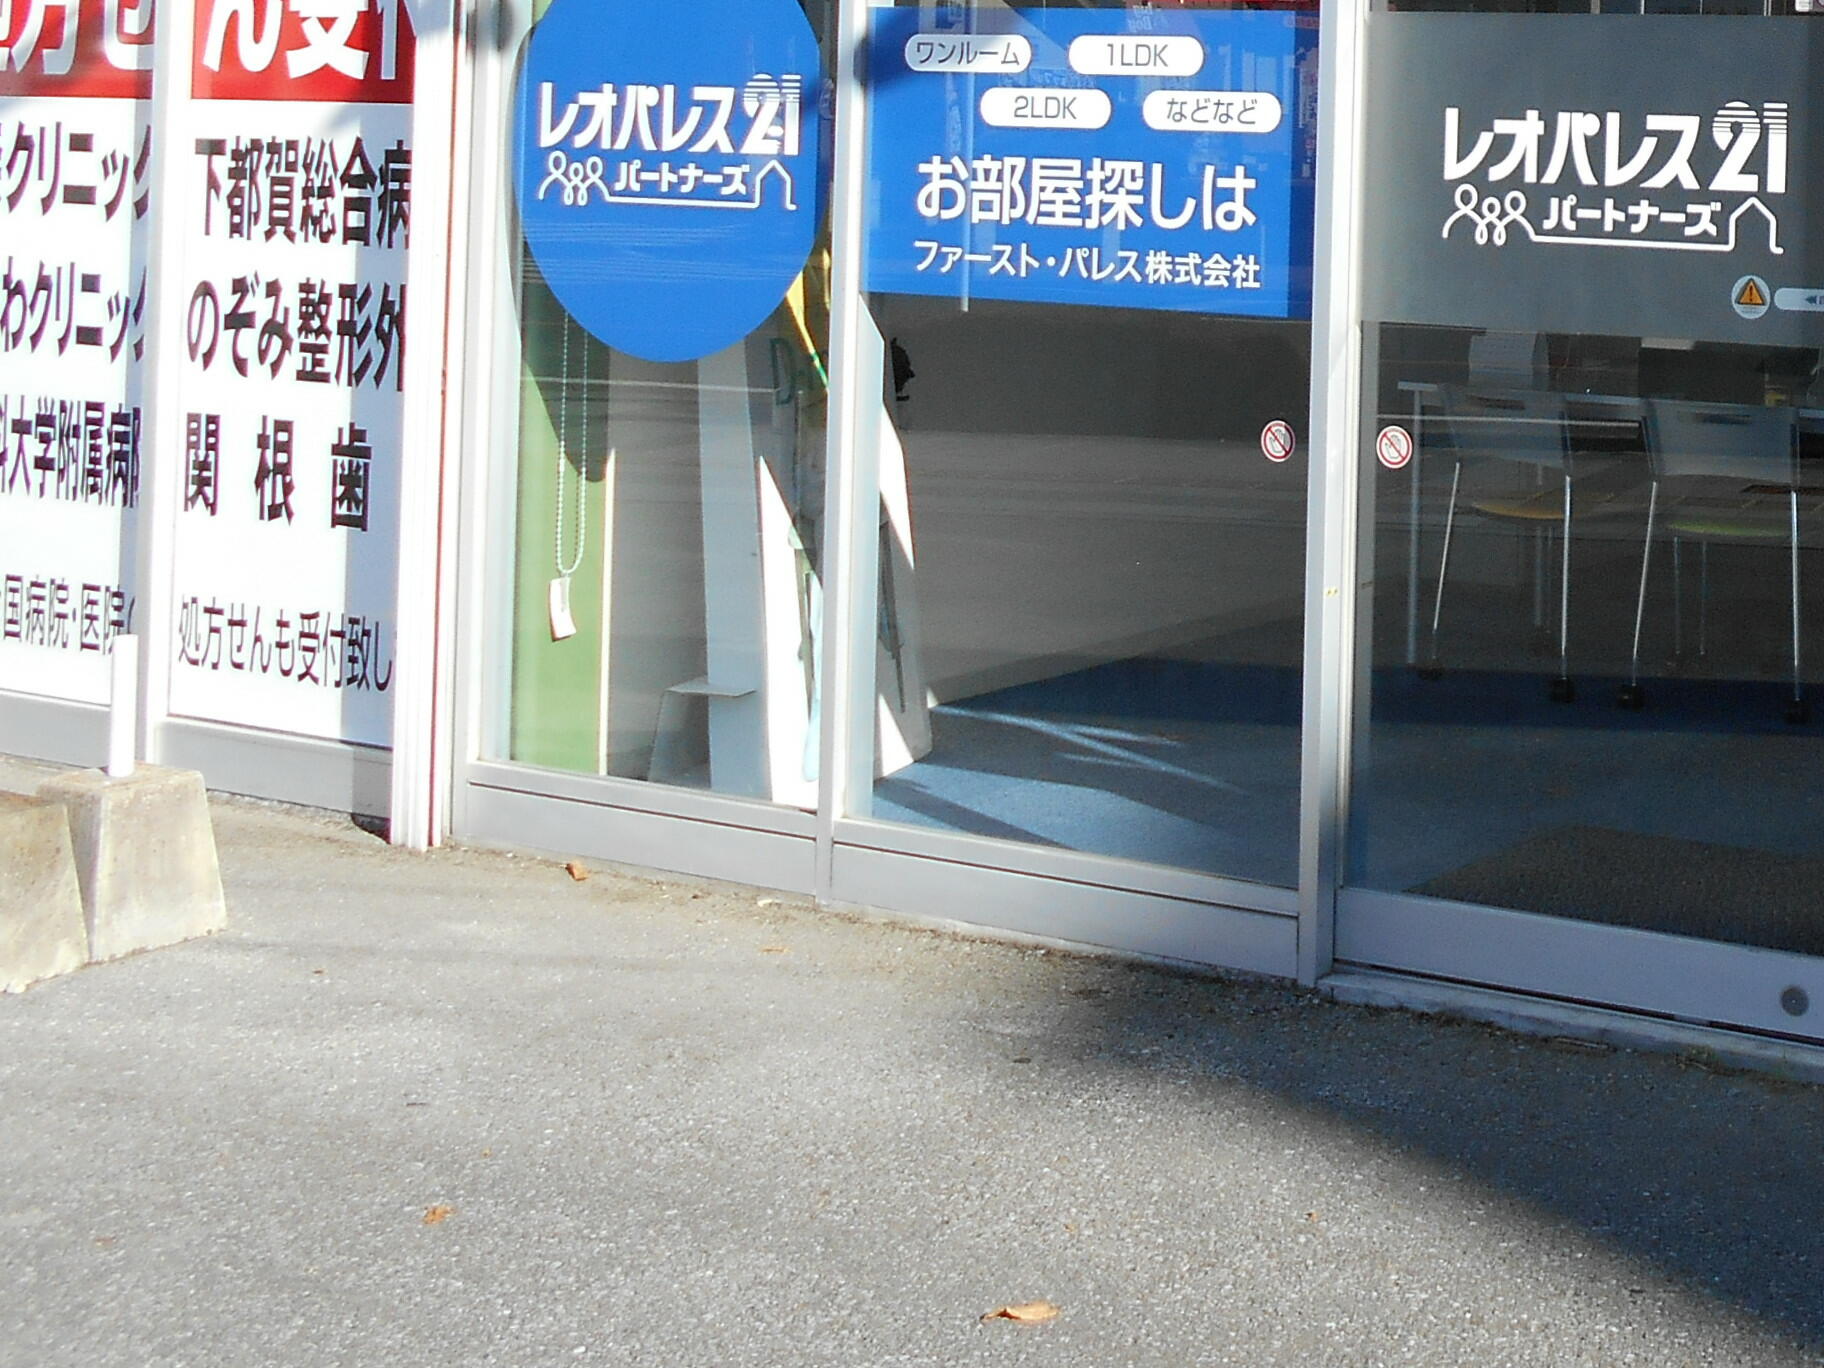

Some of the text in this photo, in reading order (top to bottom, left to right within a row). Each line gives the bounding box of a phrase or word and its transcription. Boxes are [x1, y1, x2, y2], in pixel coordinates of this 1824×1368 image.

[915, 41, 1169, 68] ワンルーム 1LDK
[538, 73, 802, 156] レオパレス21
[1014, 96, 1258, 125] 2LDK などなど
[1443, 101, 1788, 194] レオパレス21
[614, 160, 750, 196] パートナーズ
[915, 154, 1258, 231] お部屋探しは
[1542, 194, 1722, 236] パートナーズ
[913, 240, 1261, 289] ファースト・パレス株式会社
